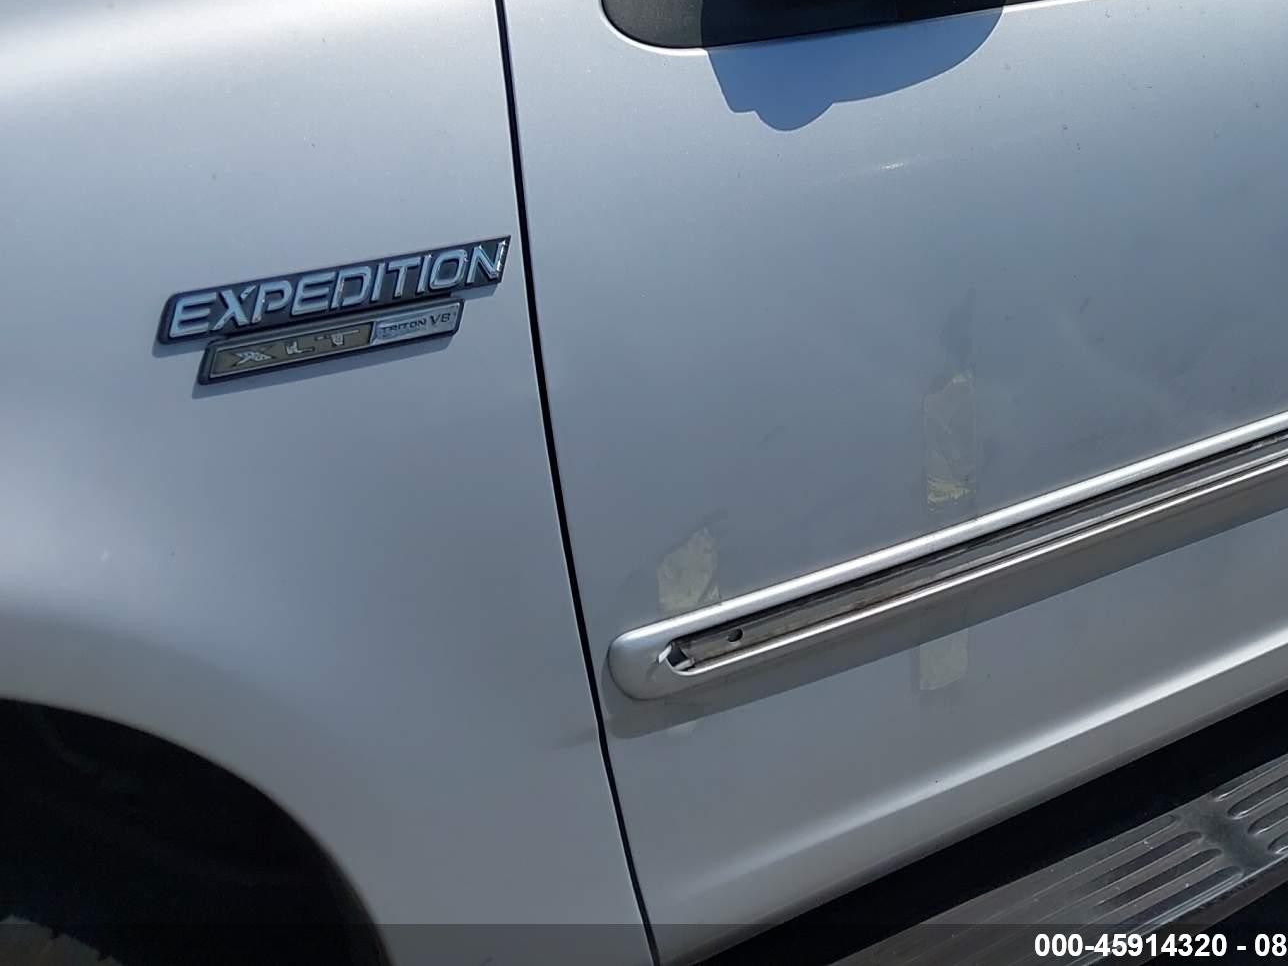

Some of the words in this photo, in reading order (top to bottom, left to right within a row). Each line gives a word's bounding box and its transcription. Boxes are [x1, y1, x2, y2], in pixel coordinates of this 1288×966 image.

[168, 238, 508, 340] EXPEDITION
[231, 328, 361, 368] XLT
[381, 318, 428, 335] TRITON
[428, 312, 451, 330] V8
